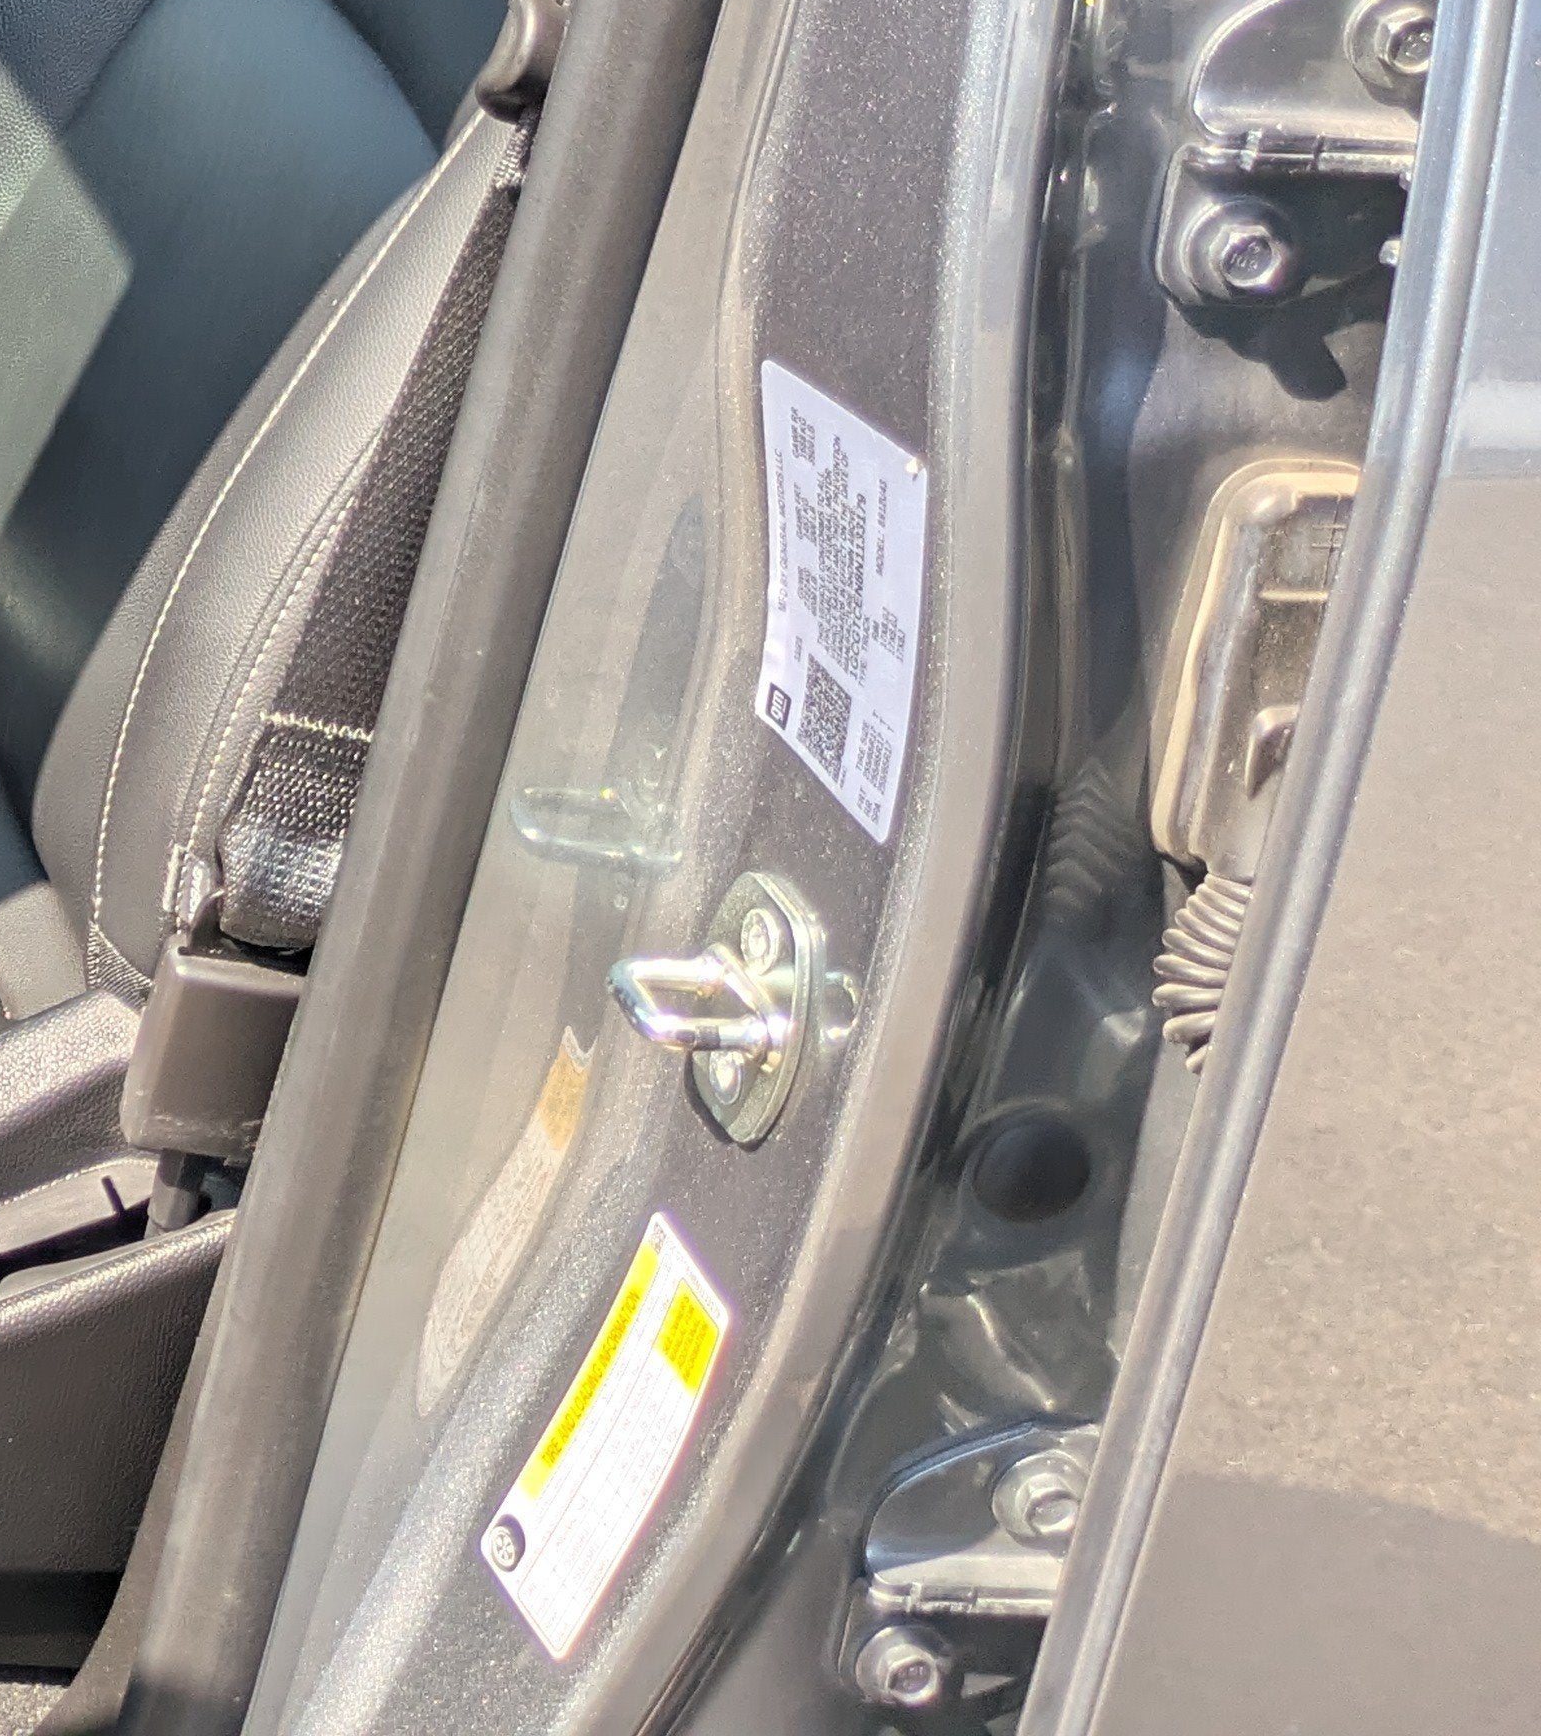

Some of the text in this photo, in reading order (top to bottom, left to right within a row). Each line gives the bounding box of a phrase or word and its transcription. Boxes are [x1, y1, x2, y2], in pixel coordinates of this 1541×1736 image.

[774, 446, 782, 471] LLC
[776, 469, 785, 518] MOTORS
[779, 518, 787, 571] GENERAL
[770, 686, 785, 725] gm
[541, 1436, 562, 1469] TIRE
[556, 1410, 576, 1444] AND
[569, 1360, 603, 1420] LOADING
[597, 1286, 640, 1369] INFORMATION
